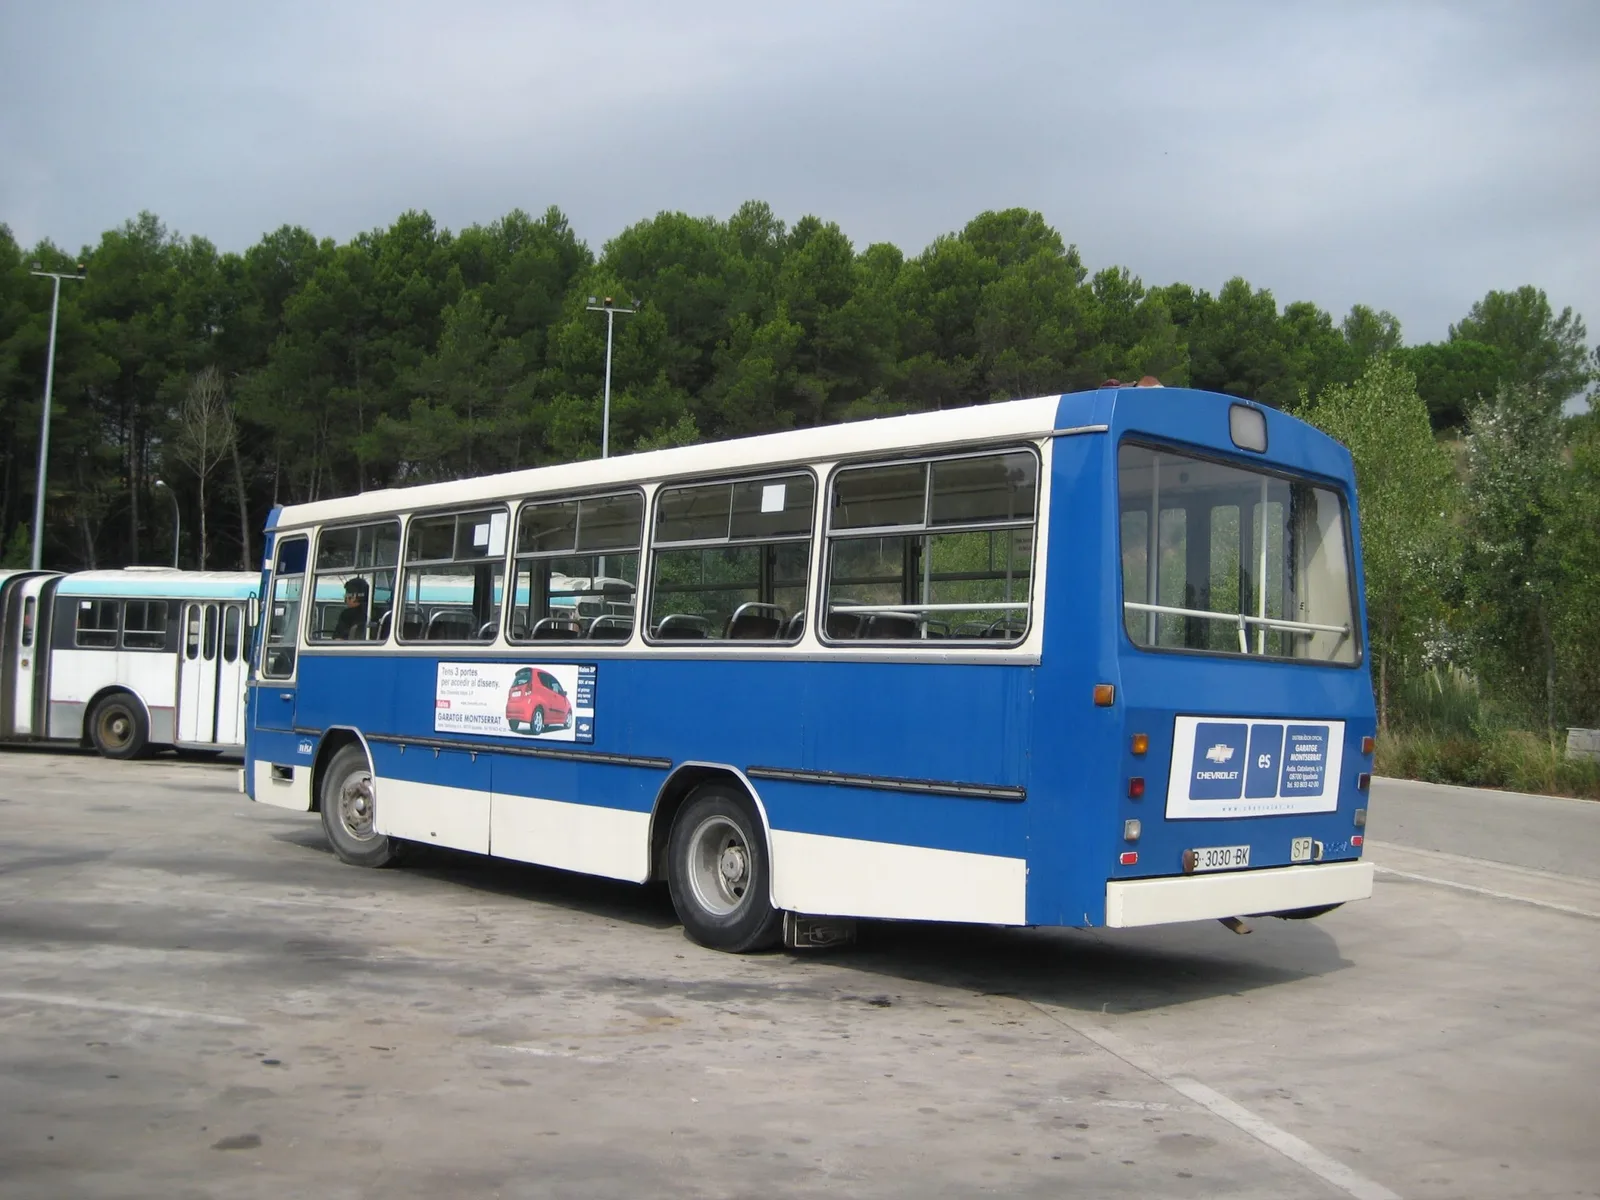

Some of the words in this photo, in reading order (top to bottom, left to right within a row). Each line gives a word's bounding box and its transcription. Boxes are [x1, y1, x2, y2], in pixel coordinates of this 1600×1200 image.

[455, 667, 459, 676] 3
[460, 668, 478, 678] portes
[451, 678, 470, 687] accedir
[438, 712, 463, 722] GARATGE
[464, 714, 501, 724] MONTSERRAT
[1295, 744, 1318, 752] GARATGE
[1258, 754, 1271, 769] es
[1290, 753, 1322, 761] MONTSERRAT
[1196, 771, 1239, 780] CHEVROLET
[1294, 840, 1310, 858] SP
